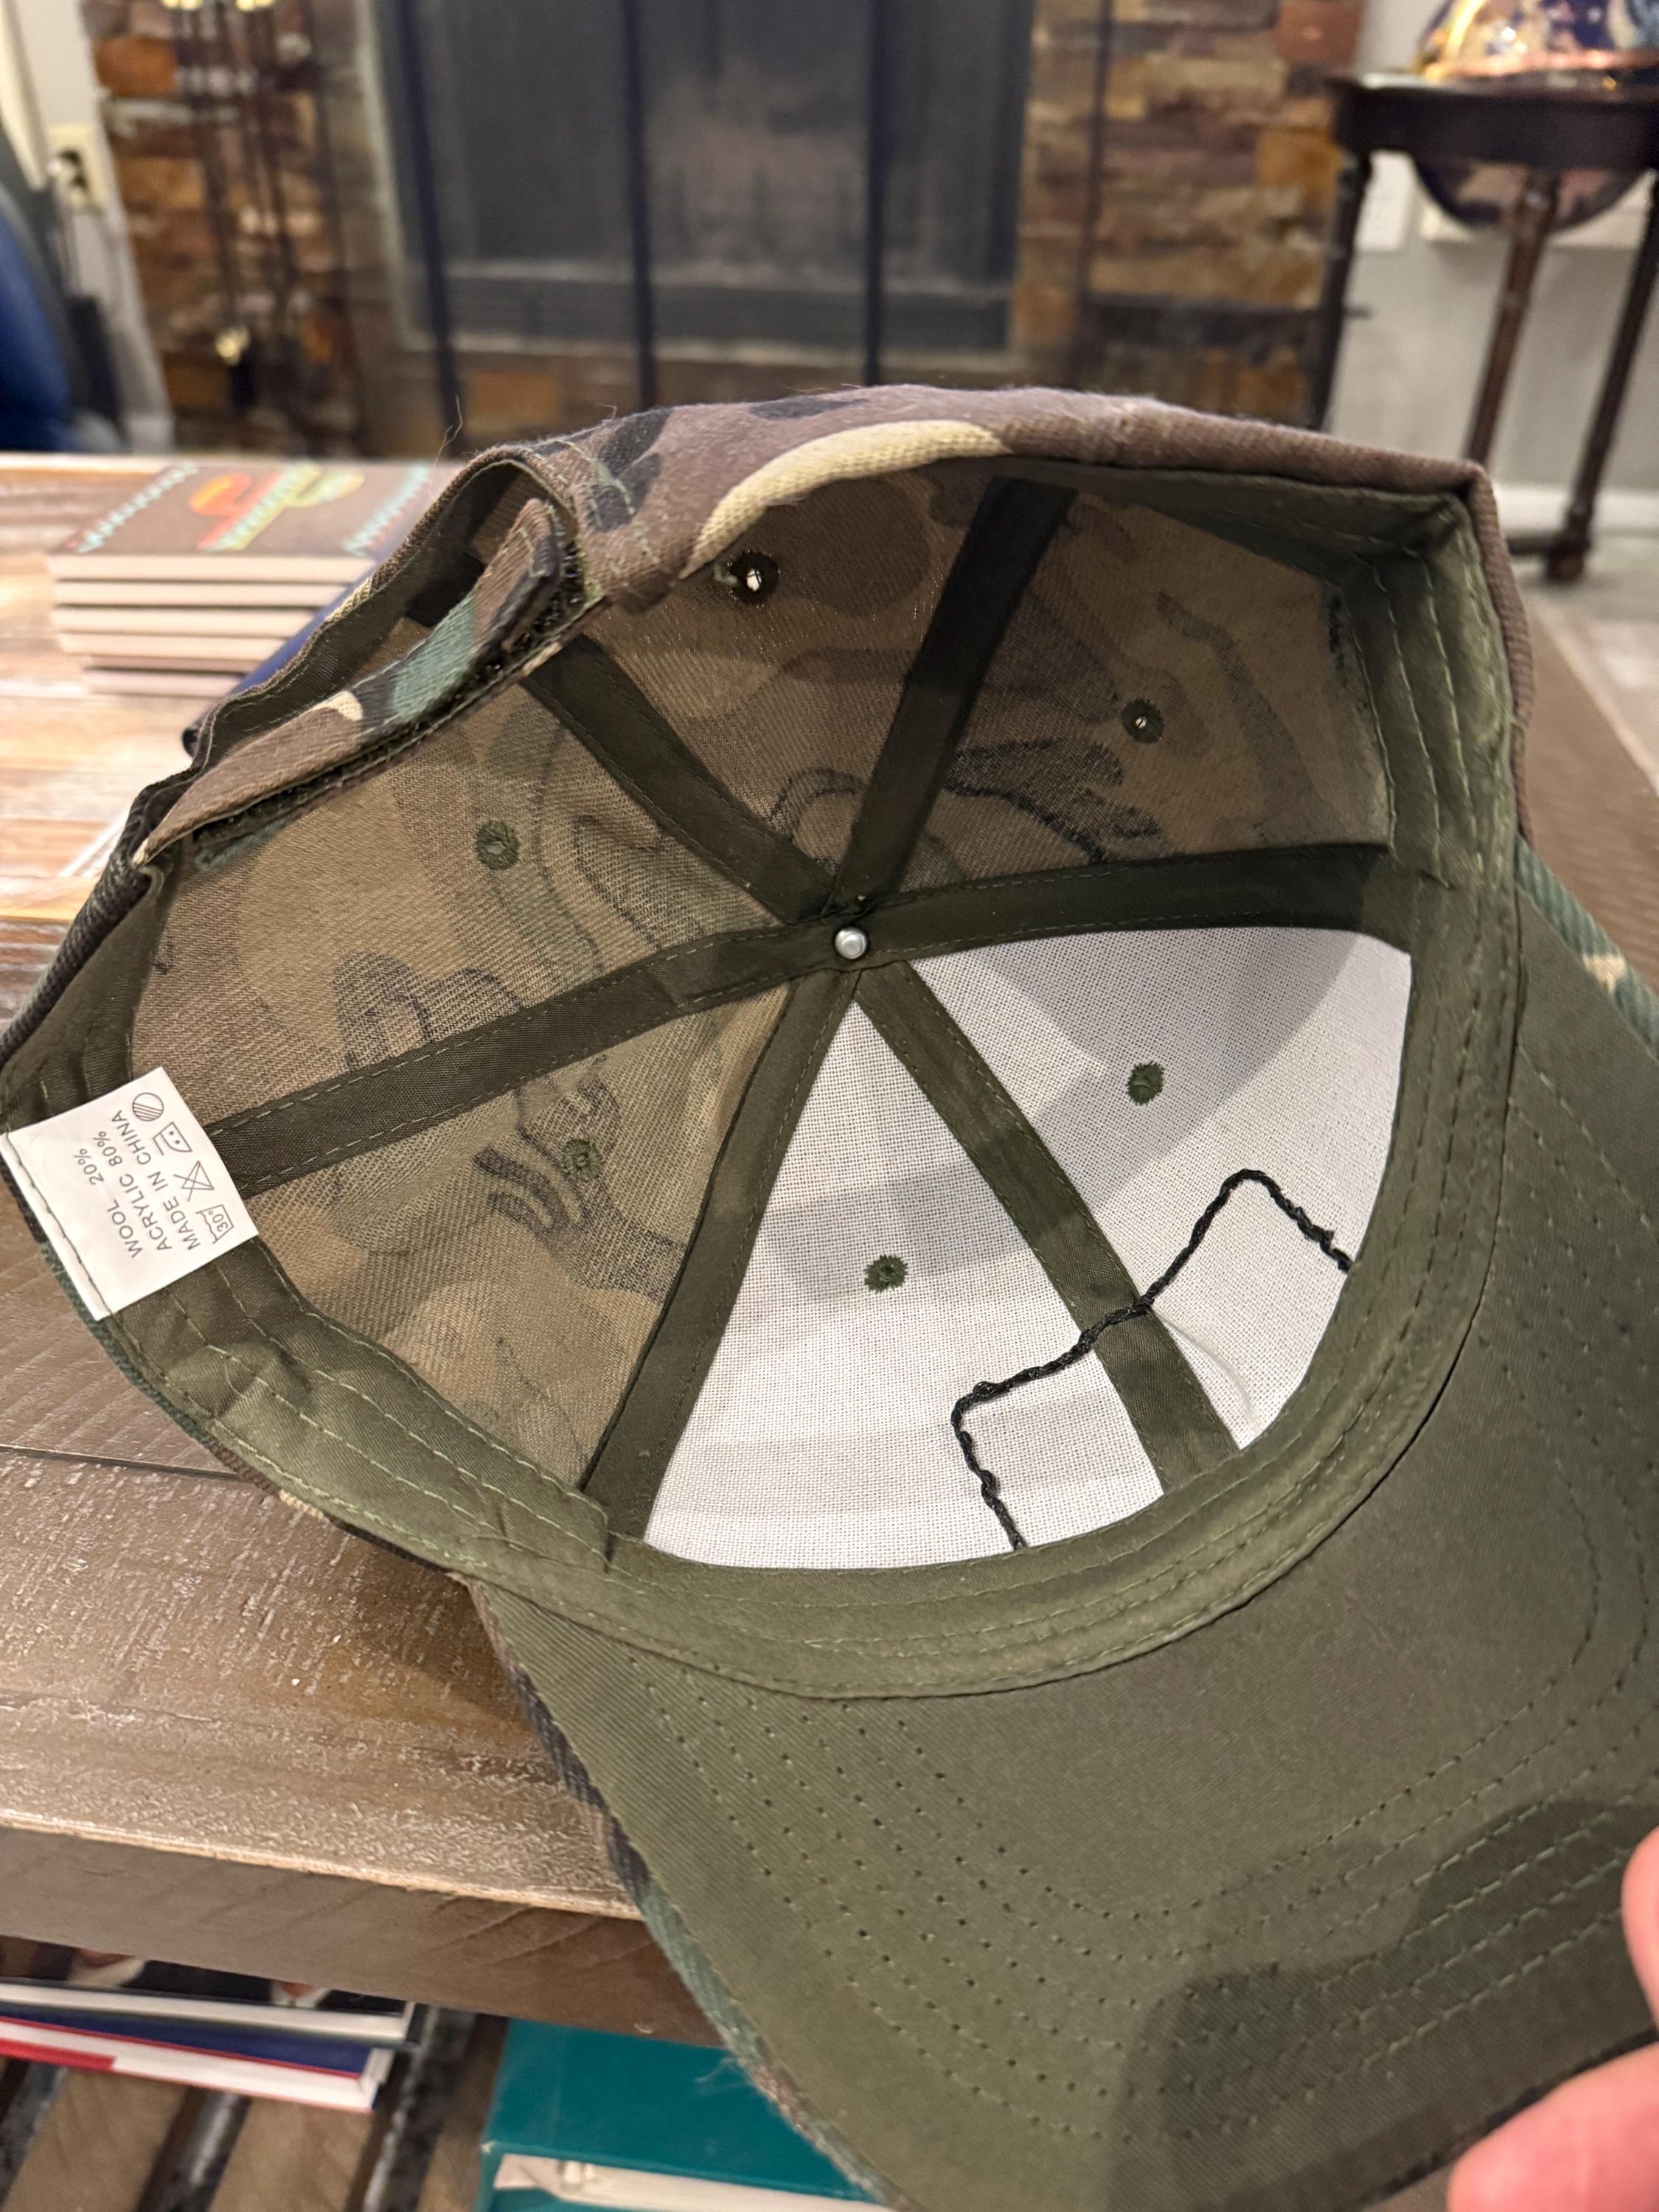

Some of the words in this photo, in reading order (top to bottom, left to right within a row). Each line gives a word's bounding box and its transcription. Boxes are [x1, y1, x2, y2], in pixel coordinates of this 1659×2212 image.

[92, 1130, 122, 1166] 80%
[111, 1110, 152, 1166] CHINA
[74, 1148, 105, 1186] 20%
[147, 1171, 169, 1192] IN
[106, 1199, 143, 1259] WOOL
[119, 1173, 173, 1251] ACRYLIC
[162, 1196, 201, 1251] MADE
